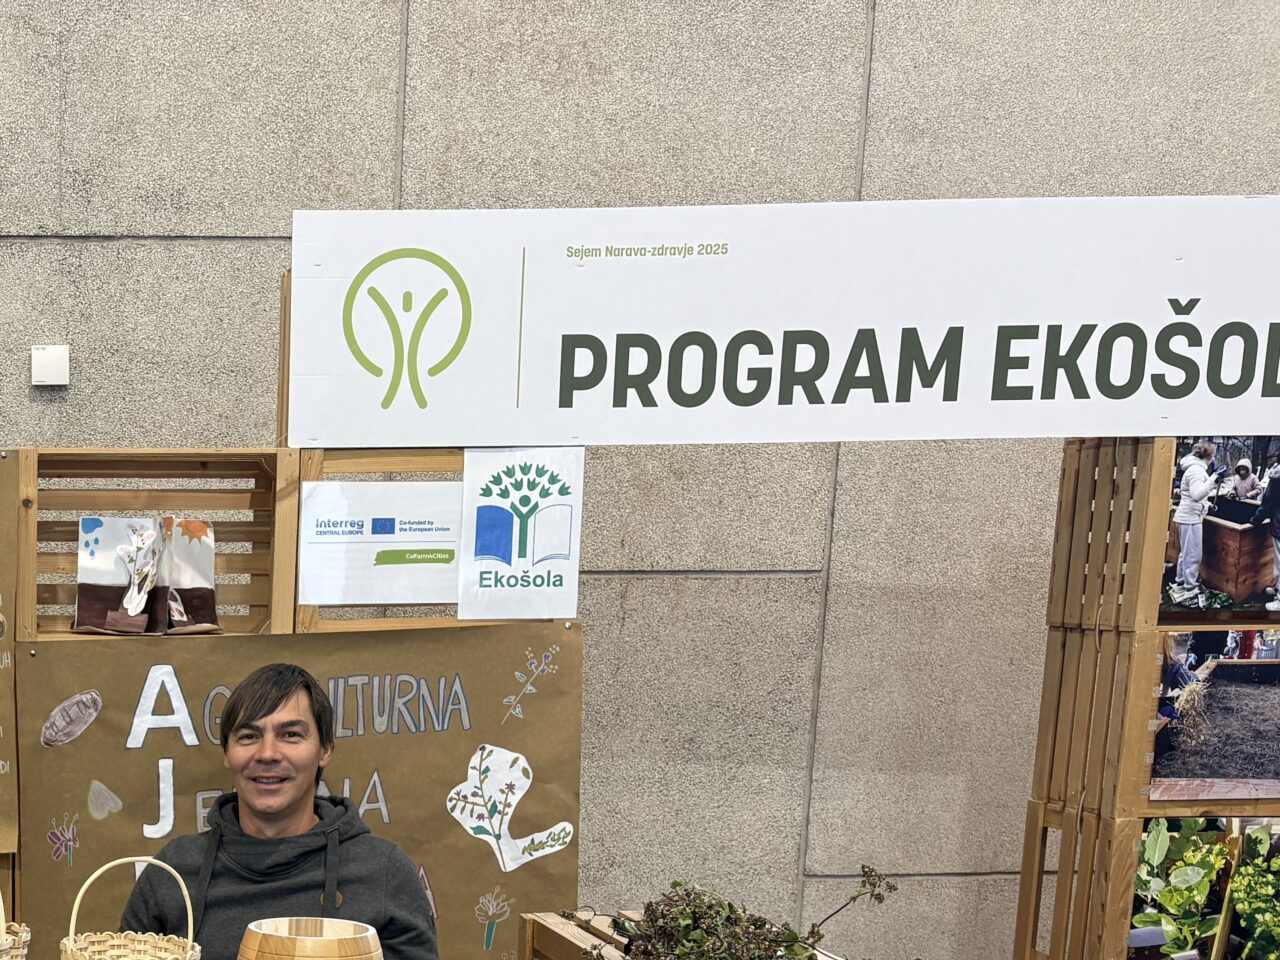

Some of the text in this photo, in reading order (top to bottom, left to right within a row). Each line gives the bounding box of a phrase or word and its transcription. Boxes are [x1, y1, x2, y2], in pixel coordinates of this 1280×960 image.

[566, 243, 729, 261] Sejem Narava-zdravje 2025
[559, 325, 965, 409] PROGRAM
[315, 518, 364, 530] Interreg
[478, 570, 564, 589] Ekošola
